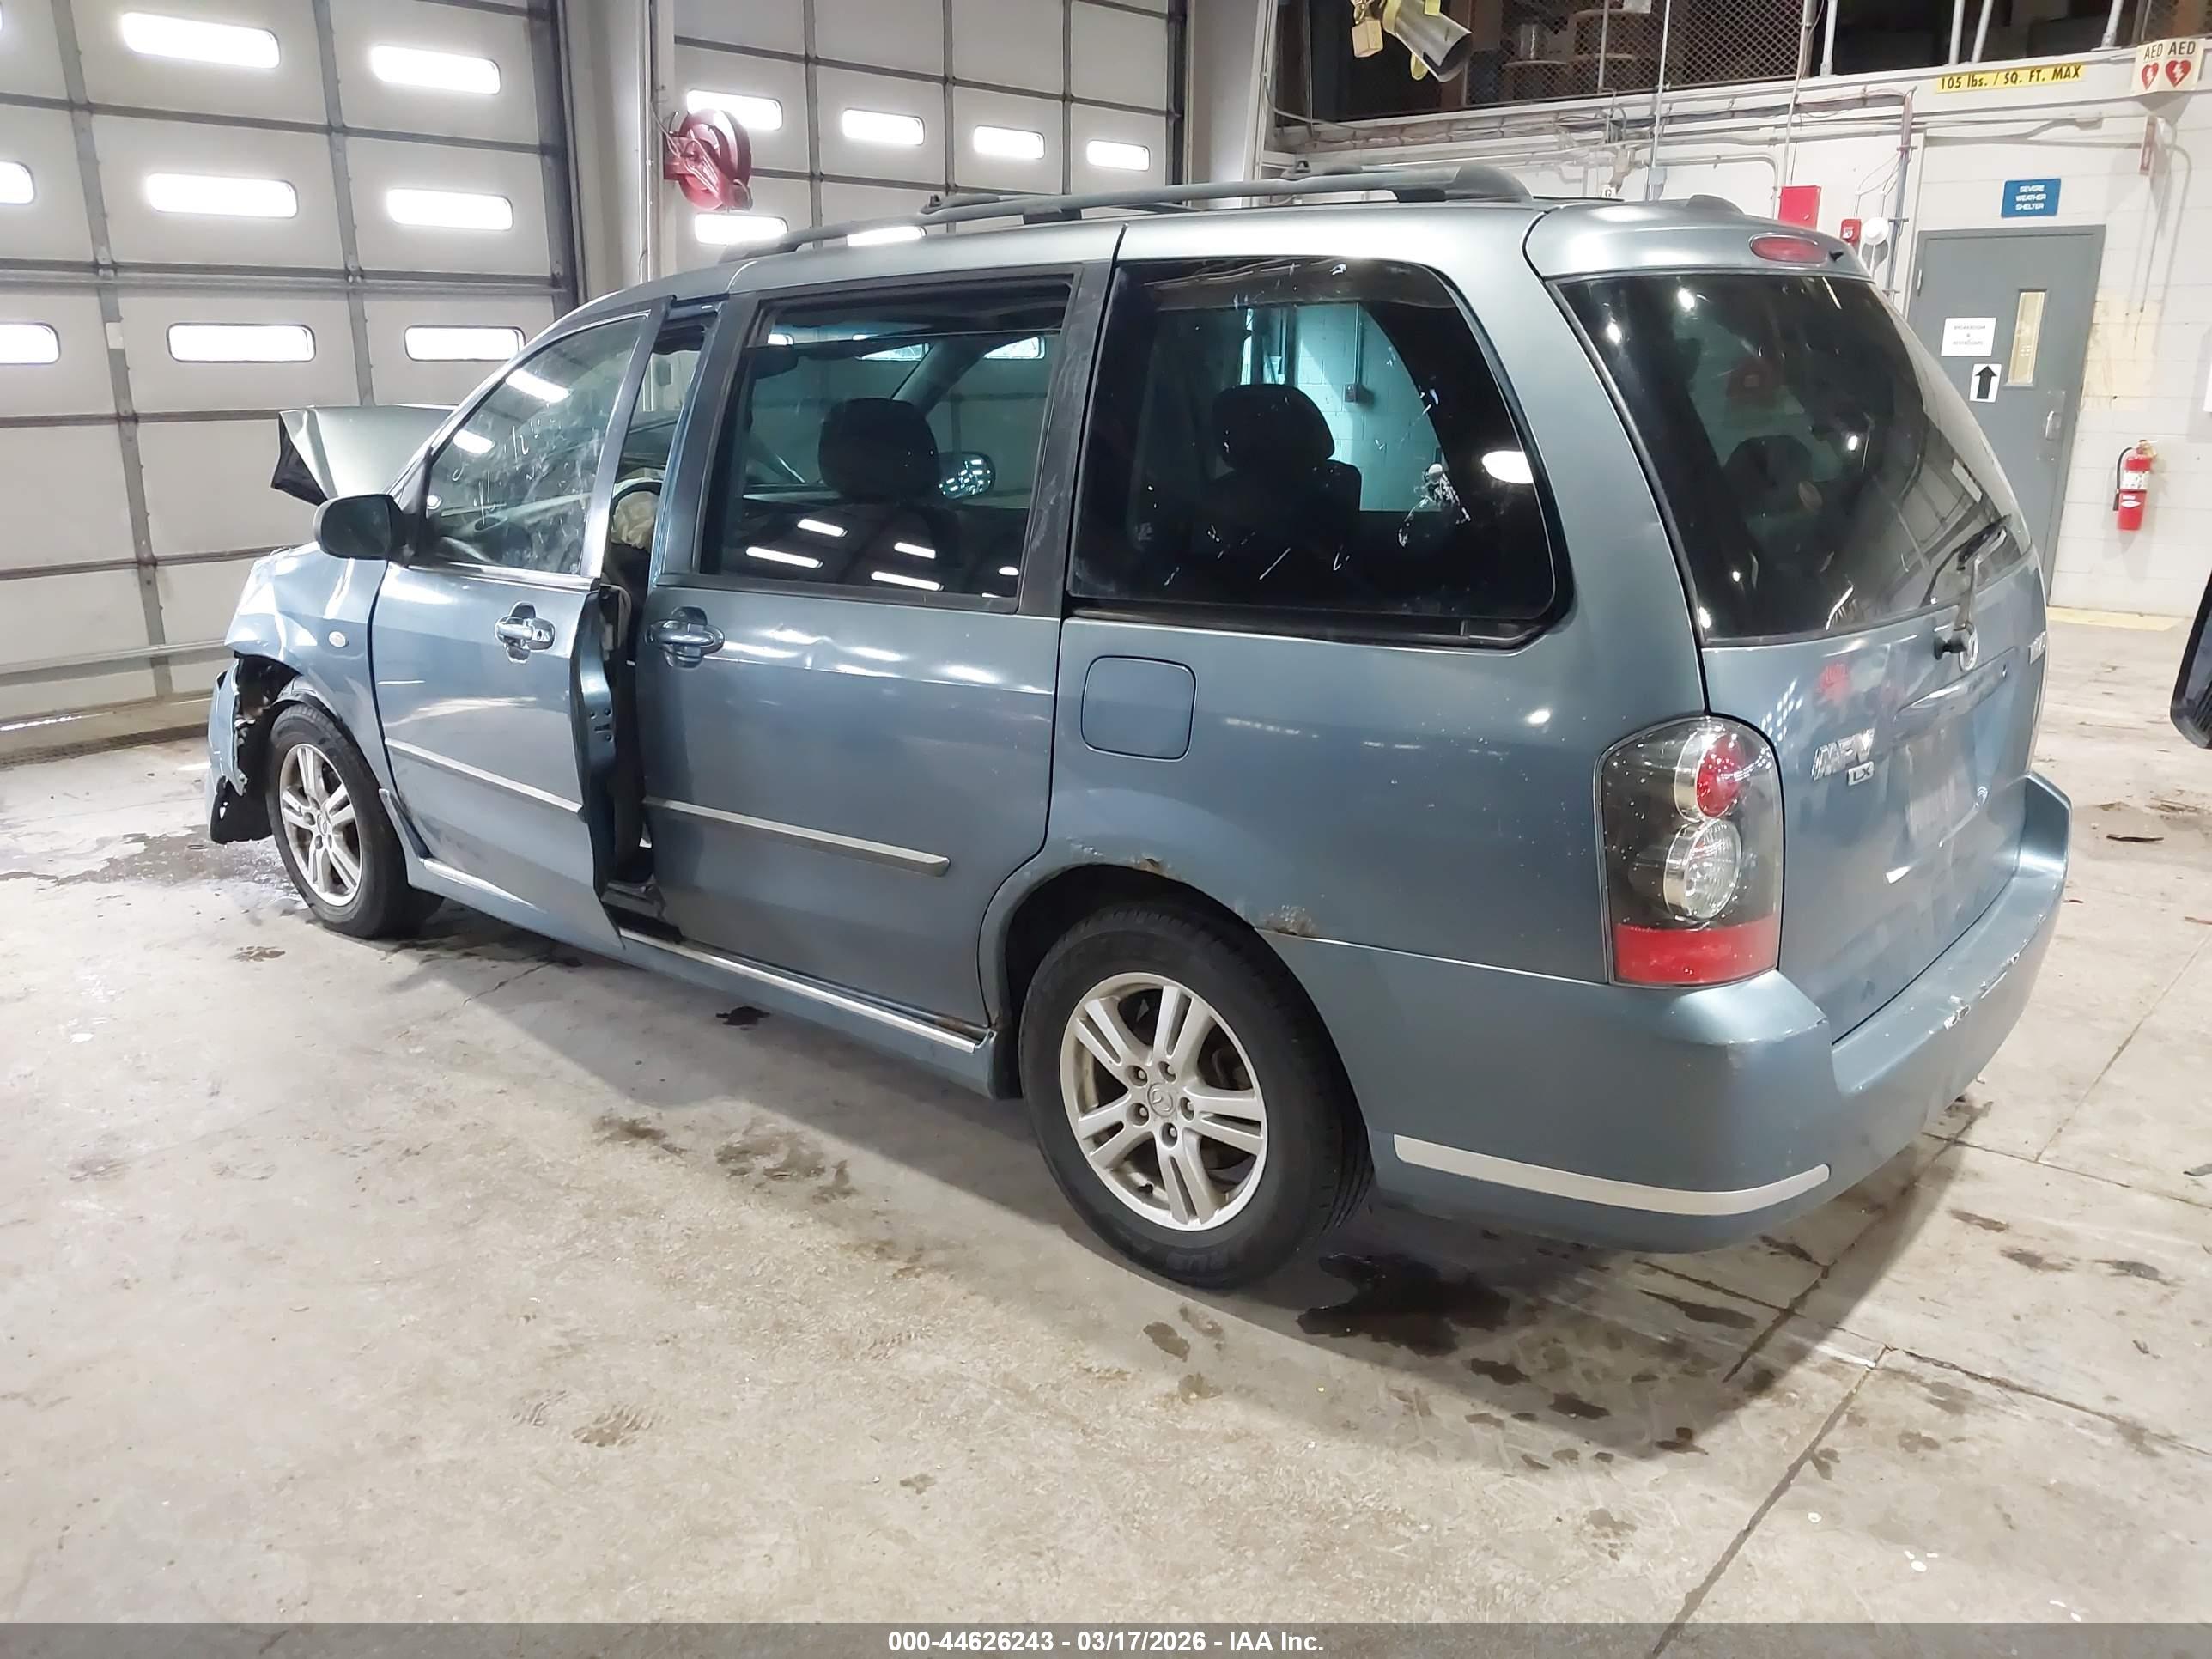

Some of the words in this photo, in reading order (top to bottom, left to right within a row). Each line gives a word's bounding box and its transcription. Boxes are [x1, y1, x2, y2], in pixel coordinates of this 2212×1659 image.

[2143, 43, 2164, 60] AED
[2167, 40, 2197, 56] AED
[1941, 76, 1962, 90] 105
[1966, 73, 1989, 88] lbs.
[1993, 72, 2000, 86] /
[2003, 71, 2024, 85] SQ.
[2028, 68, 2046, 82] FT.
[2051, 64, 2082, 81] MAX
[2019, 185, 2045, 193] SEVERE
[2015, 193, 2047, 202] WEATHER
